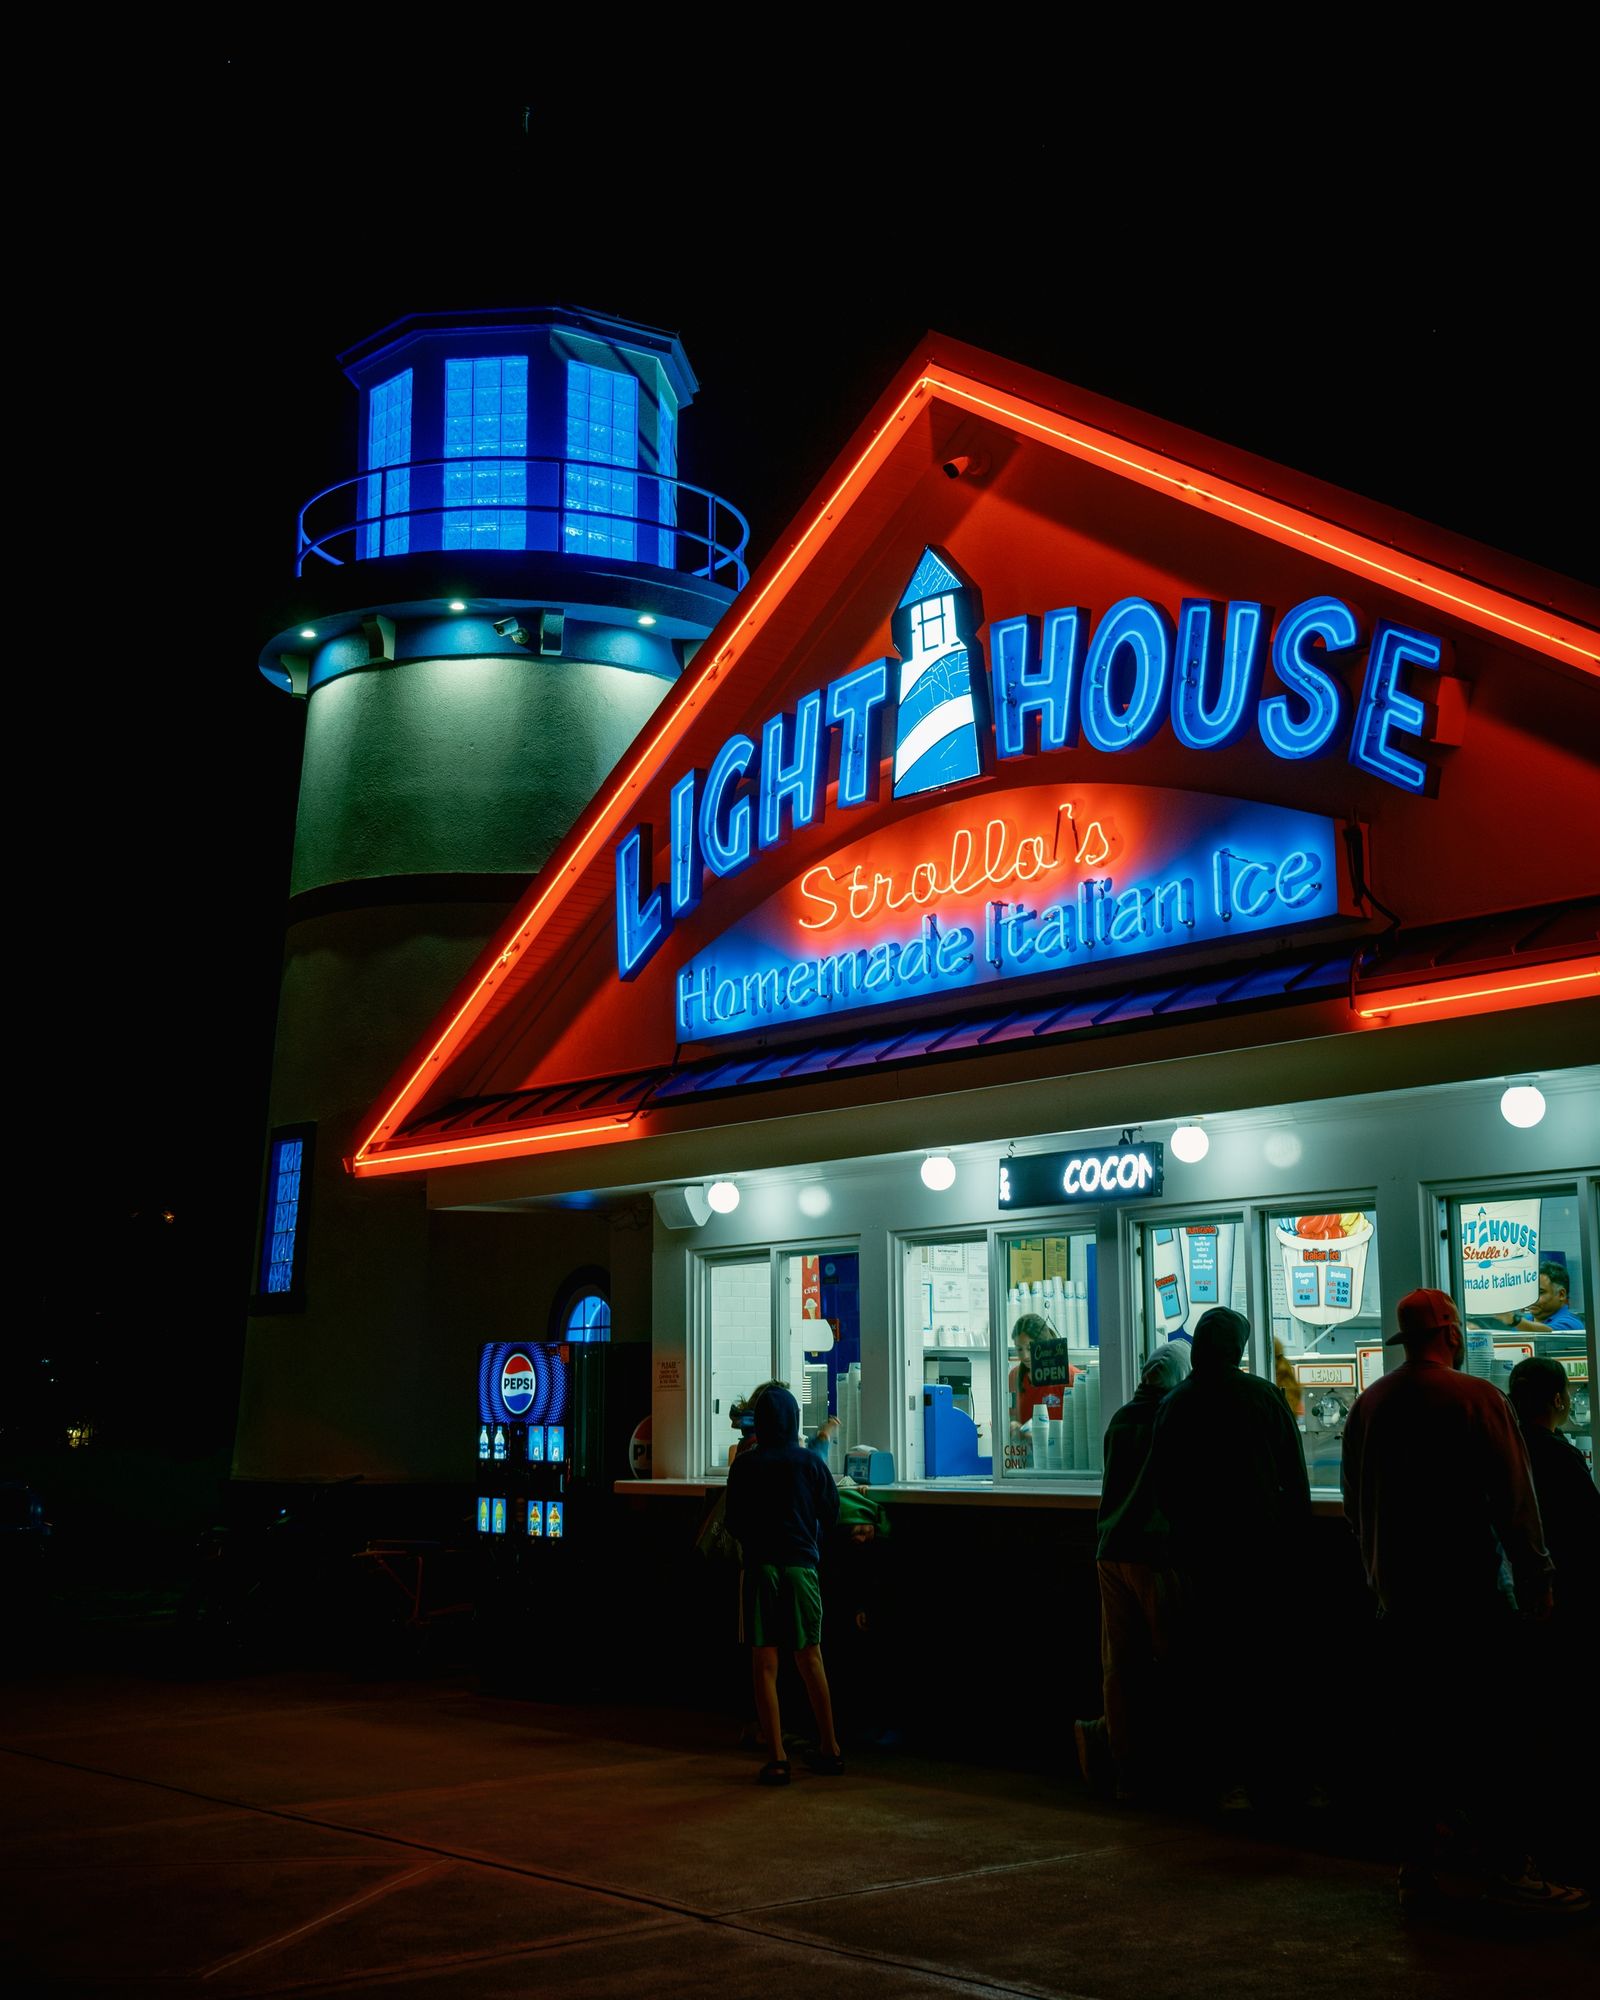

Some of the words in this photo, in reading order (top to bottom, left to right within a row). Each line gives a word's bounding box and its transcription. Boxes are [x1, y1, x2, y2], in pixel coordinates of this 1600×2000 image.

[615, 657, 896, 981] LIGHT
[990, 596, 1442, 796] HOUSE
[799, 803, 1110, 928] Strollo's
[679, 914, 973, 1028] Homemade
[986, 879, 1194, 967] Italian
[1213, 848, 1322, 920] Ice
[1488, 1219, 1537, 1254] HOUSE
[1463, 1246, 1509, 1260] Strollo's
[1492, 1273, 1521, 1288] Italian
[1524, 1270, 1537, 1283] Ice
[1035, 1366, 1066, 1381] OPEN
[1311, 1369, 1343, 1383] LEMON
[504, 1377, 533, 1390] PEPSI
[1004, 1445, 1028, 1457] CASH
[1004, 1458, 1028, 1470] ONLY
